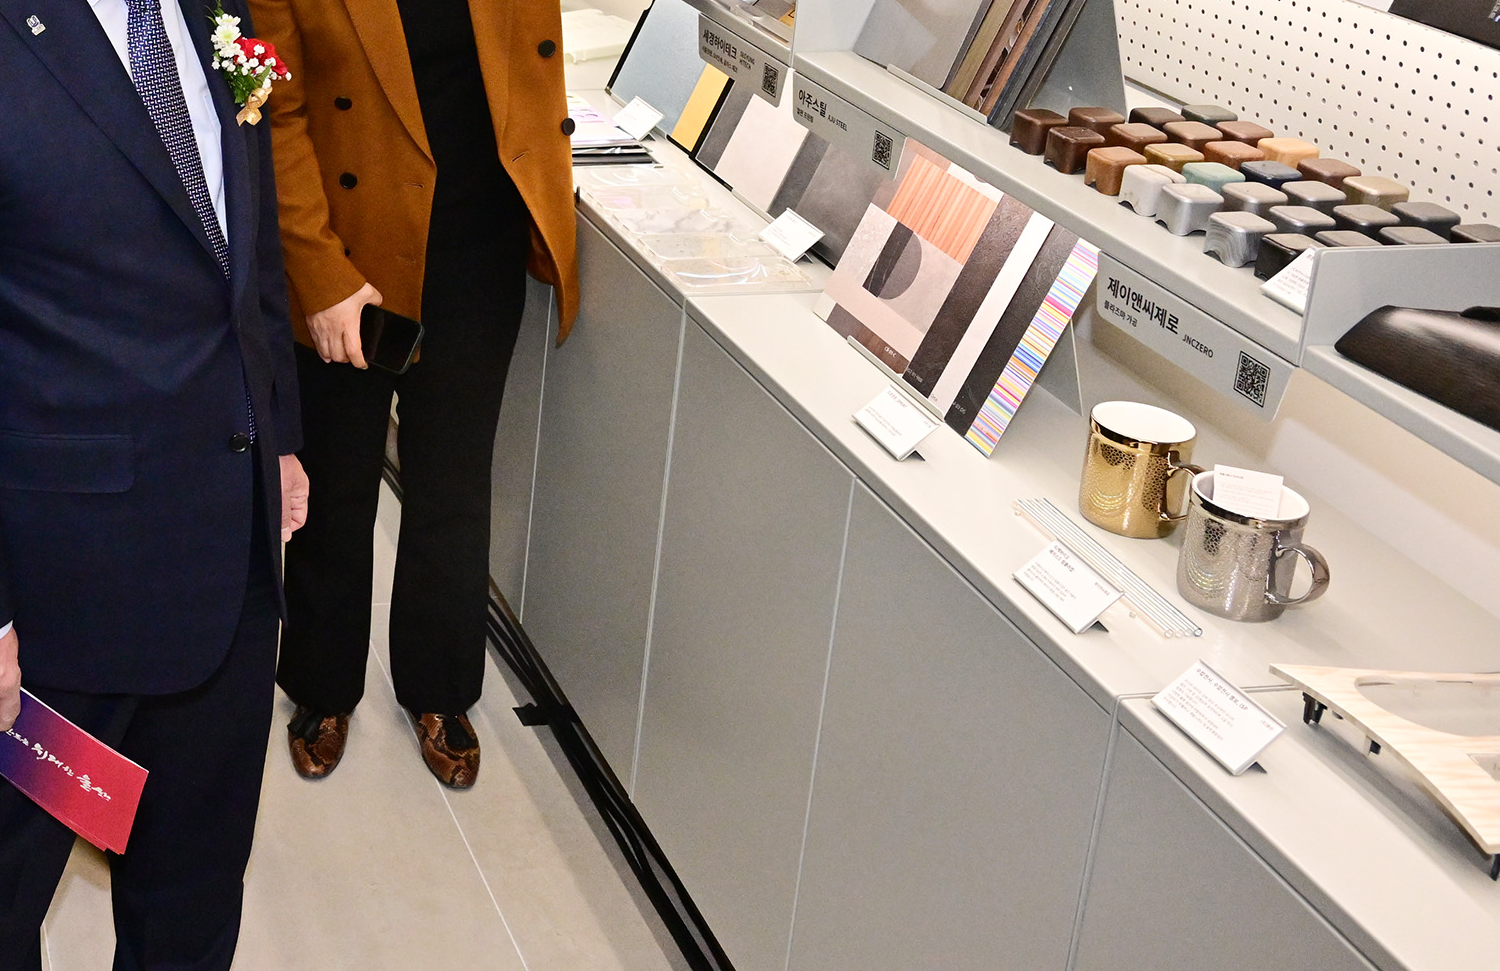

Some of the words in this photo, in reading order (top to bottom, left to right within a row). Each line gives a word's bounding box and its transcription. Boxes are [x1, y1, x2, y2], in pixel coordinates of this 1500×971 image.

[702, 29, 738, 60] 세경하이테크
[798, 89, 827, 118] 아주스틸
[827, 114, 835, 124] AJU
[835, 118, 848, 131] STEEL
[1103, 299, 1126, 321] 플라즈마
[1126, 314, 1138, 328] 가공
[1107, 277, 1180, 335] 제이앤씨제로
[1181, 333, 1214, 358] JNCZERO
